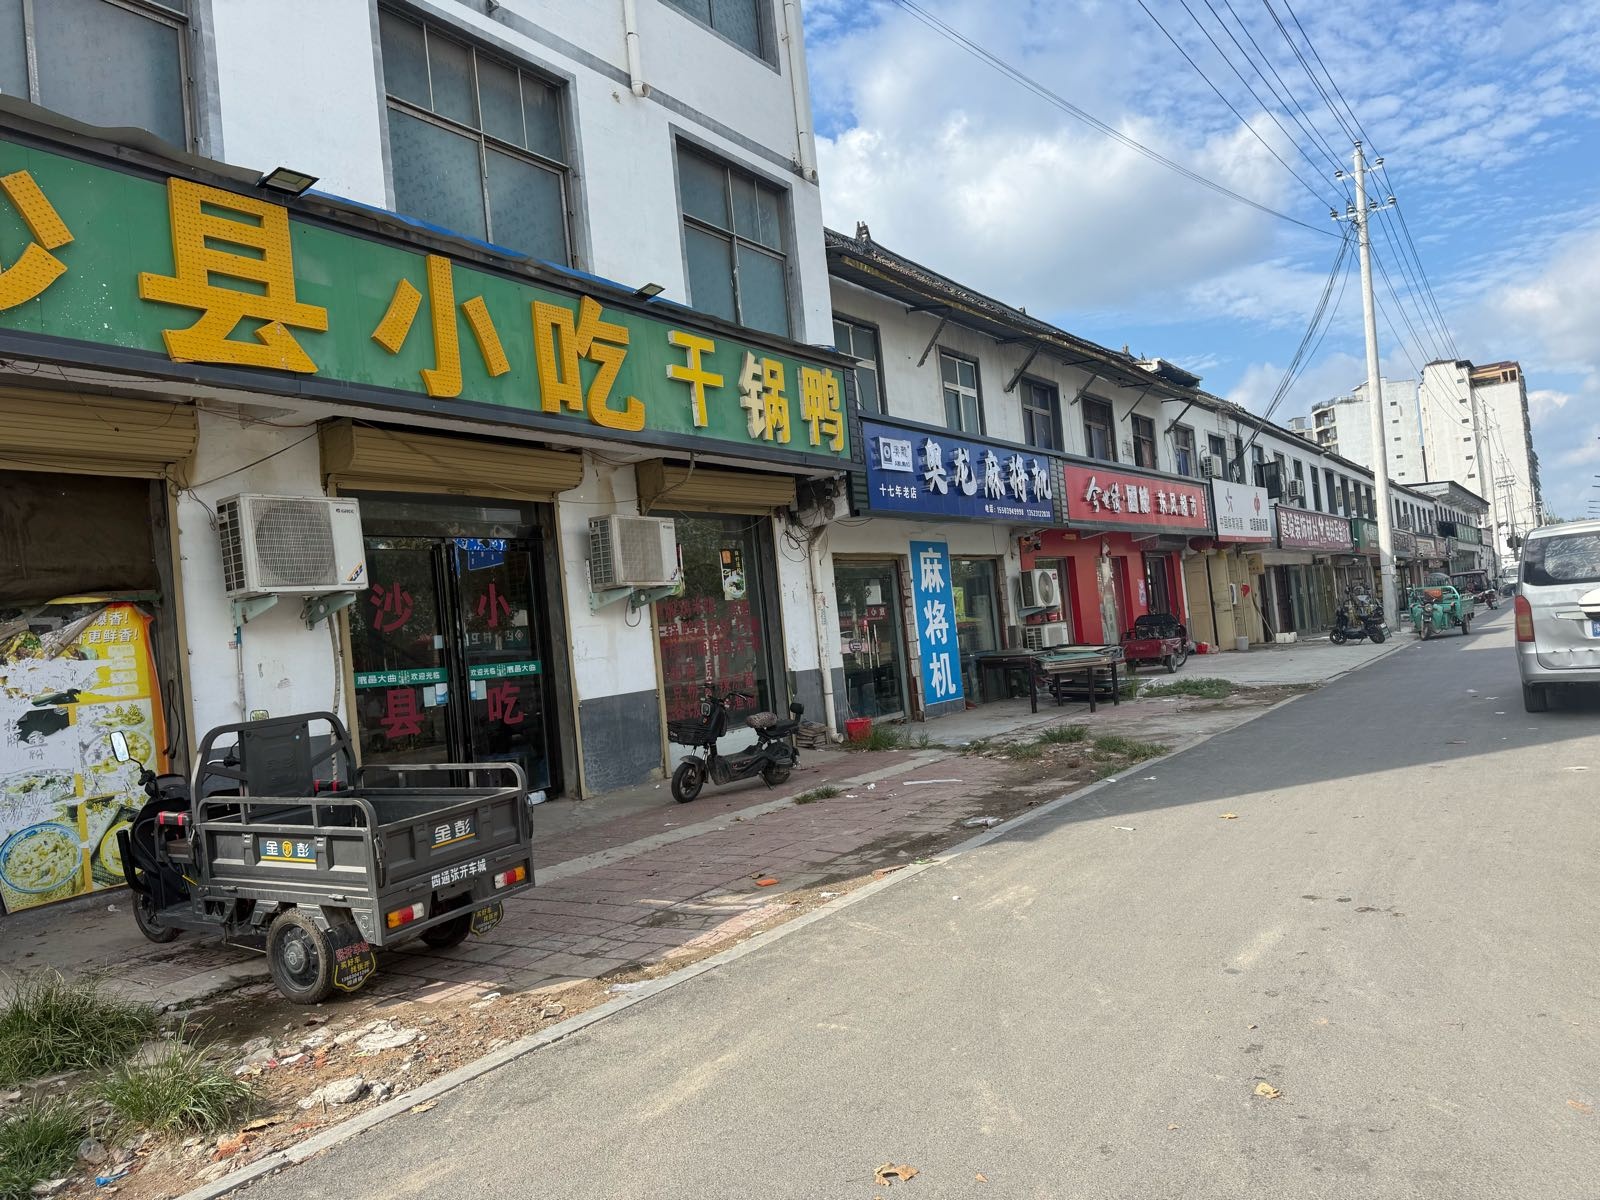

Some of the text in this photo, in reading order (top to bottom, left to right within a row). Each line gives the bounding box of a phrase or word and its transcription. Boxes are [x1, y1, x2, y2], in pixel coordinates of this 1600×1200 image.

[924, 438, 1052, 502] 奥龙麻将机
[879, 483, 917, 499] 十七年老店
[919, 547, 957, 698] 麻将机
[410, 671, 441, 681] 欢迎光临
[470, 667, 497, 677] 欢迎光临
[434, 818, 471, 844] 金彭
